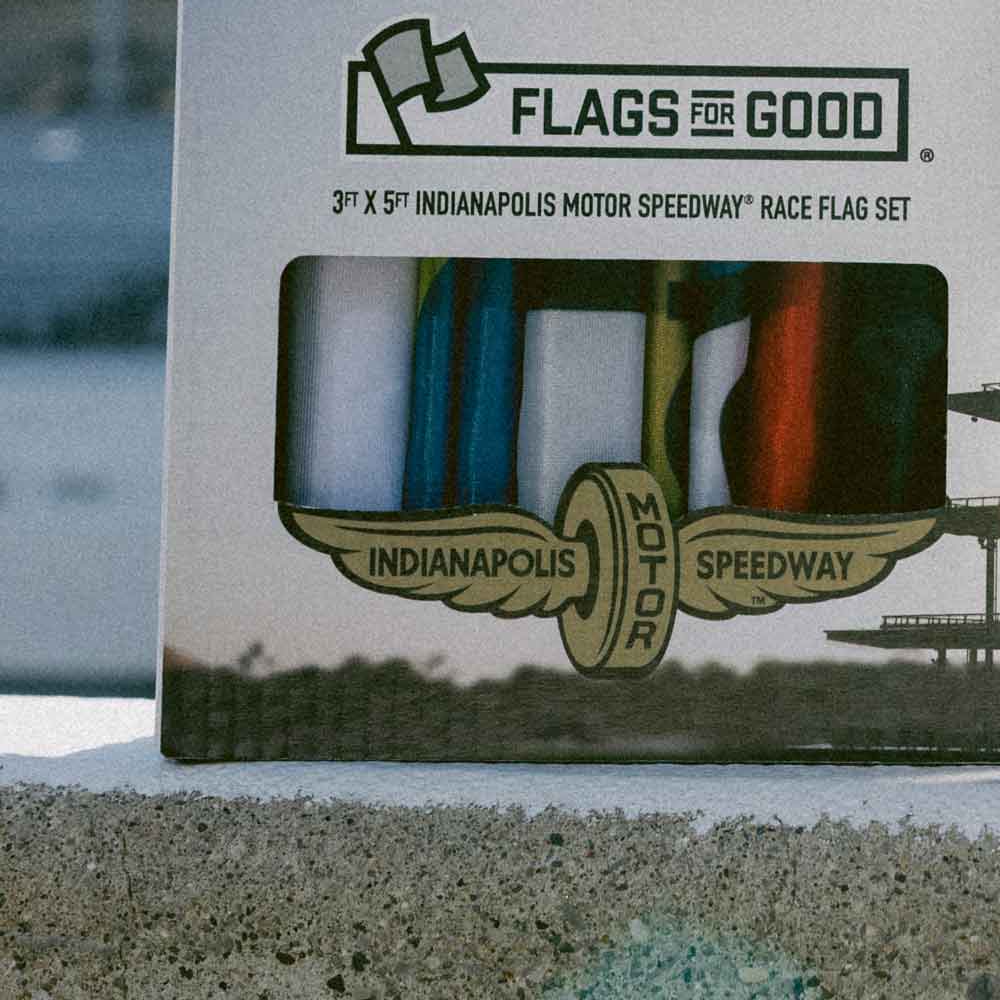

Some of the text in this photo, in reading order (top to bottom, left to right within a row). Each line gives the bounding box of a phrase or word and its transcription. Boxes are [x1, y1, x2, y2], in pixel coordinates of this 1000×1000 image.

[512, 88, 678, 136] FLAGS
[691, 103, 734, 124] FOR
[747, 91, 882, 139] GOOD
[333, 190, 358, 214] 3FT
[364, 190, 376, 214] X
[384, 190, 409, 215] 5FT
[416, 191, 555, 216] INDIANAPOLIS
[563, 193, 631, 217] MOTOR
[761, 195, 812, 219] RACE
[819, 196, 868, 220] FLAG
[876, 196, 911, 221] SET
[369, 548, 575, 577] INDIANAPOLIS
[625, 493, 666, 650] MOTOR
[697, 550, 853, 580] SPEEDWAY
